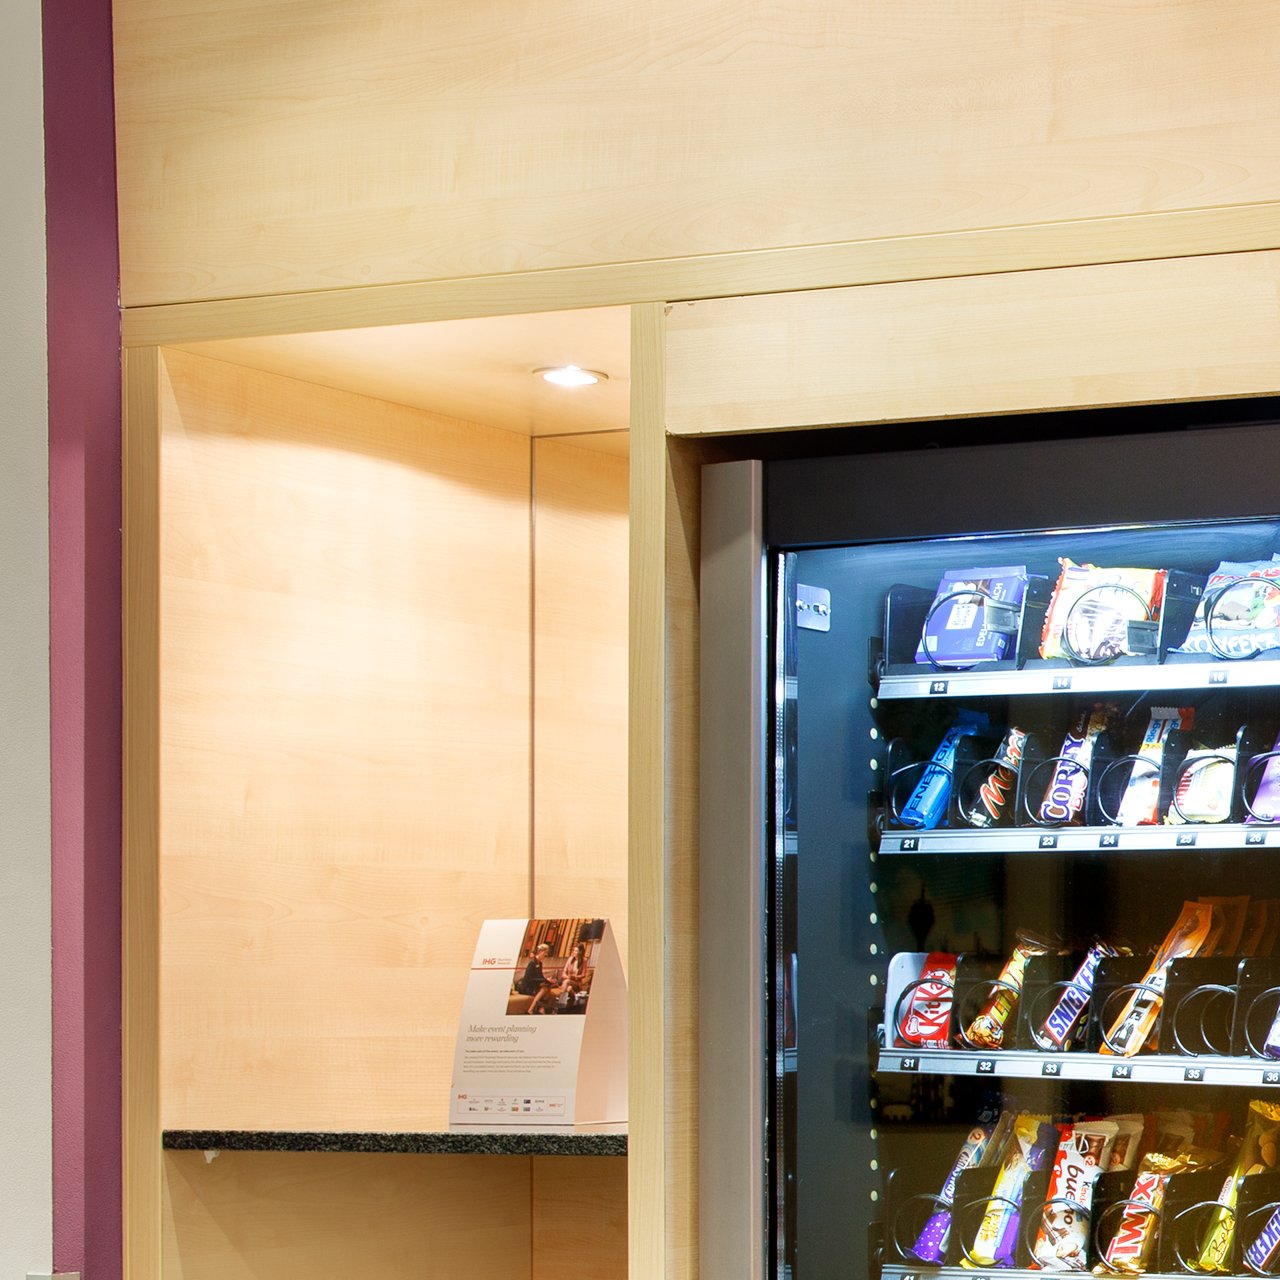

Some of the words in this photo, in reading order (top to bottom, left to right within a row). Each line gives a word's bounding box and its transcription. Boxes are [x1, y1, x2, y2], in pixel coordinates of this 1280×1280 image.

[934, 682, 945, 692] 12
[1042, 837, 1054, 846] 23
[1103, 836, 1114, 844] 24
[1180, 836, 1192, 844] 25
[1250, 834, 1261, 842] 26
[904, 840, 914, 848] 21
[904, 1059, 914, 1068] 31
[980, 1062, 992, 1070] 32
[1046, 1064, 1057, 1073] 33
[1116, 1066, 1128, 1076] 34
[1188, 1070, 1200, 1078] 35
[1266, 1072, 1278, 1082] 36
